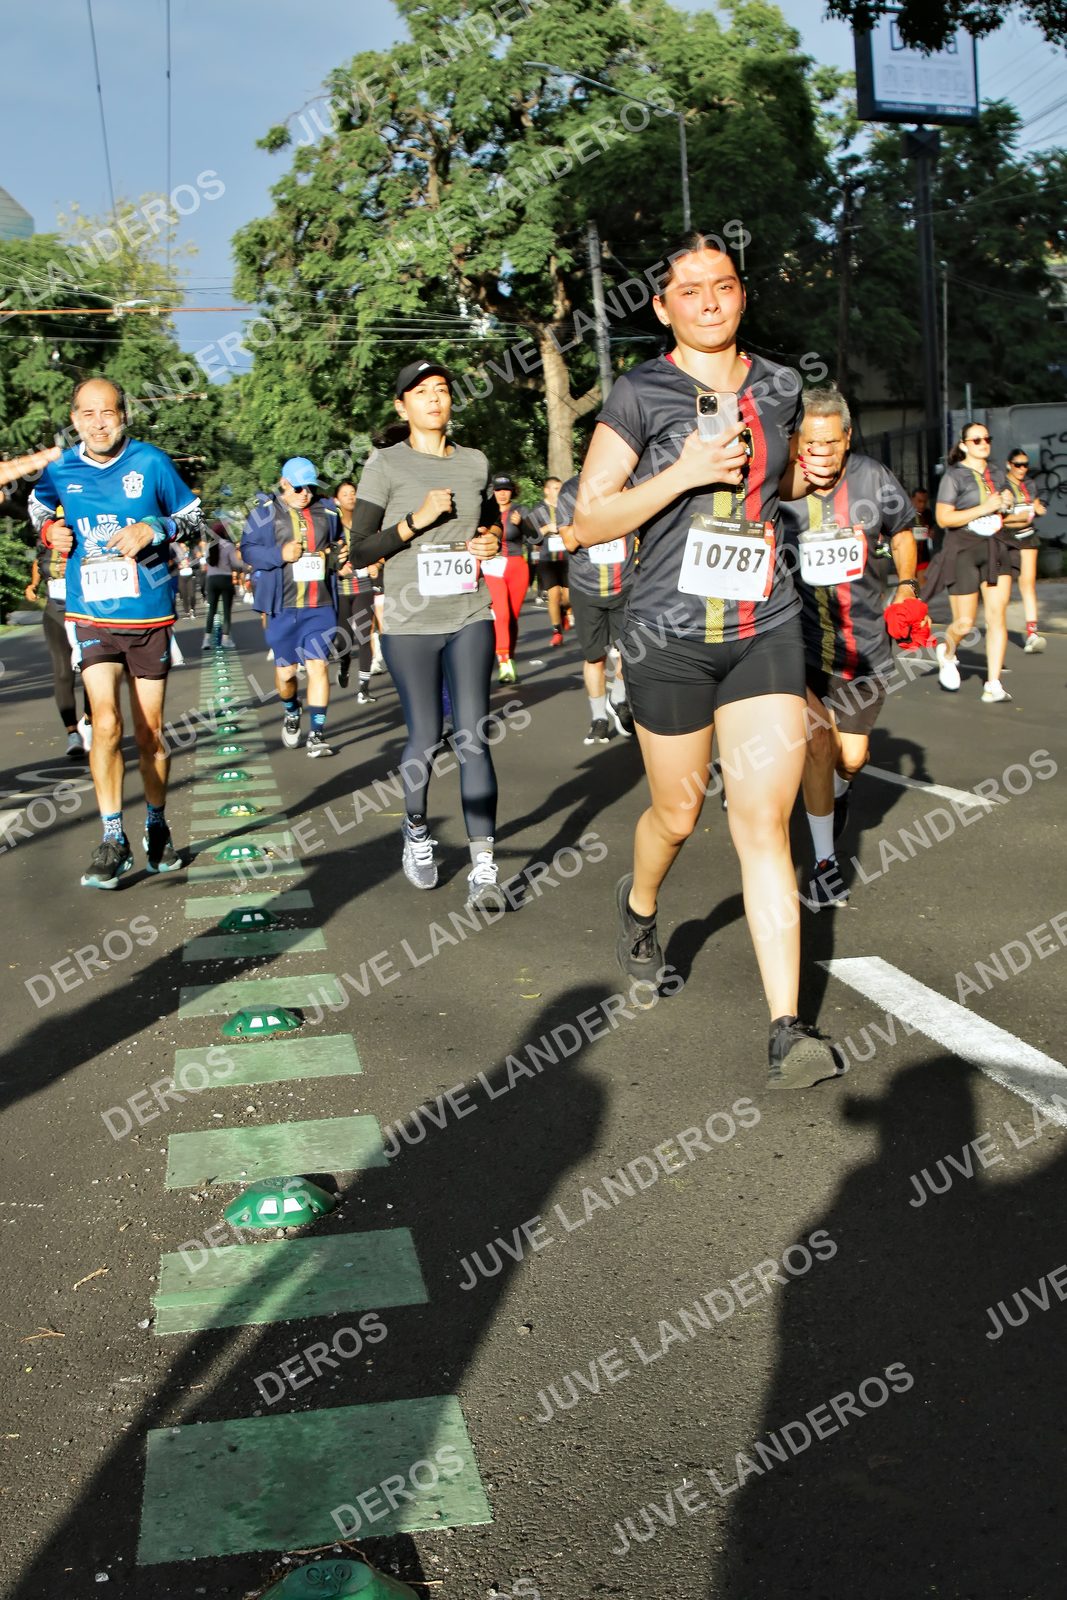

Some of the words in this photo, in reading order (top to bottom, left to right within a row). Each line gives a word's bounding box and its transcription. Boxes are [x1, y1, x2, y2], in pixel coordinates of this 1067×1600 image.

[692, 541, 766, 574] 10787
[803, 545, 859, 568] 12396
[84, 567, 129, 585] 11719
[422, 558, 473, 577] 12766
